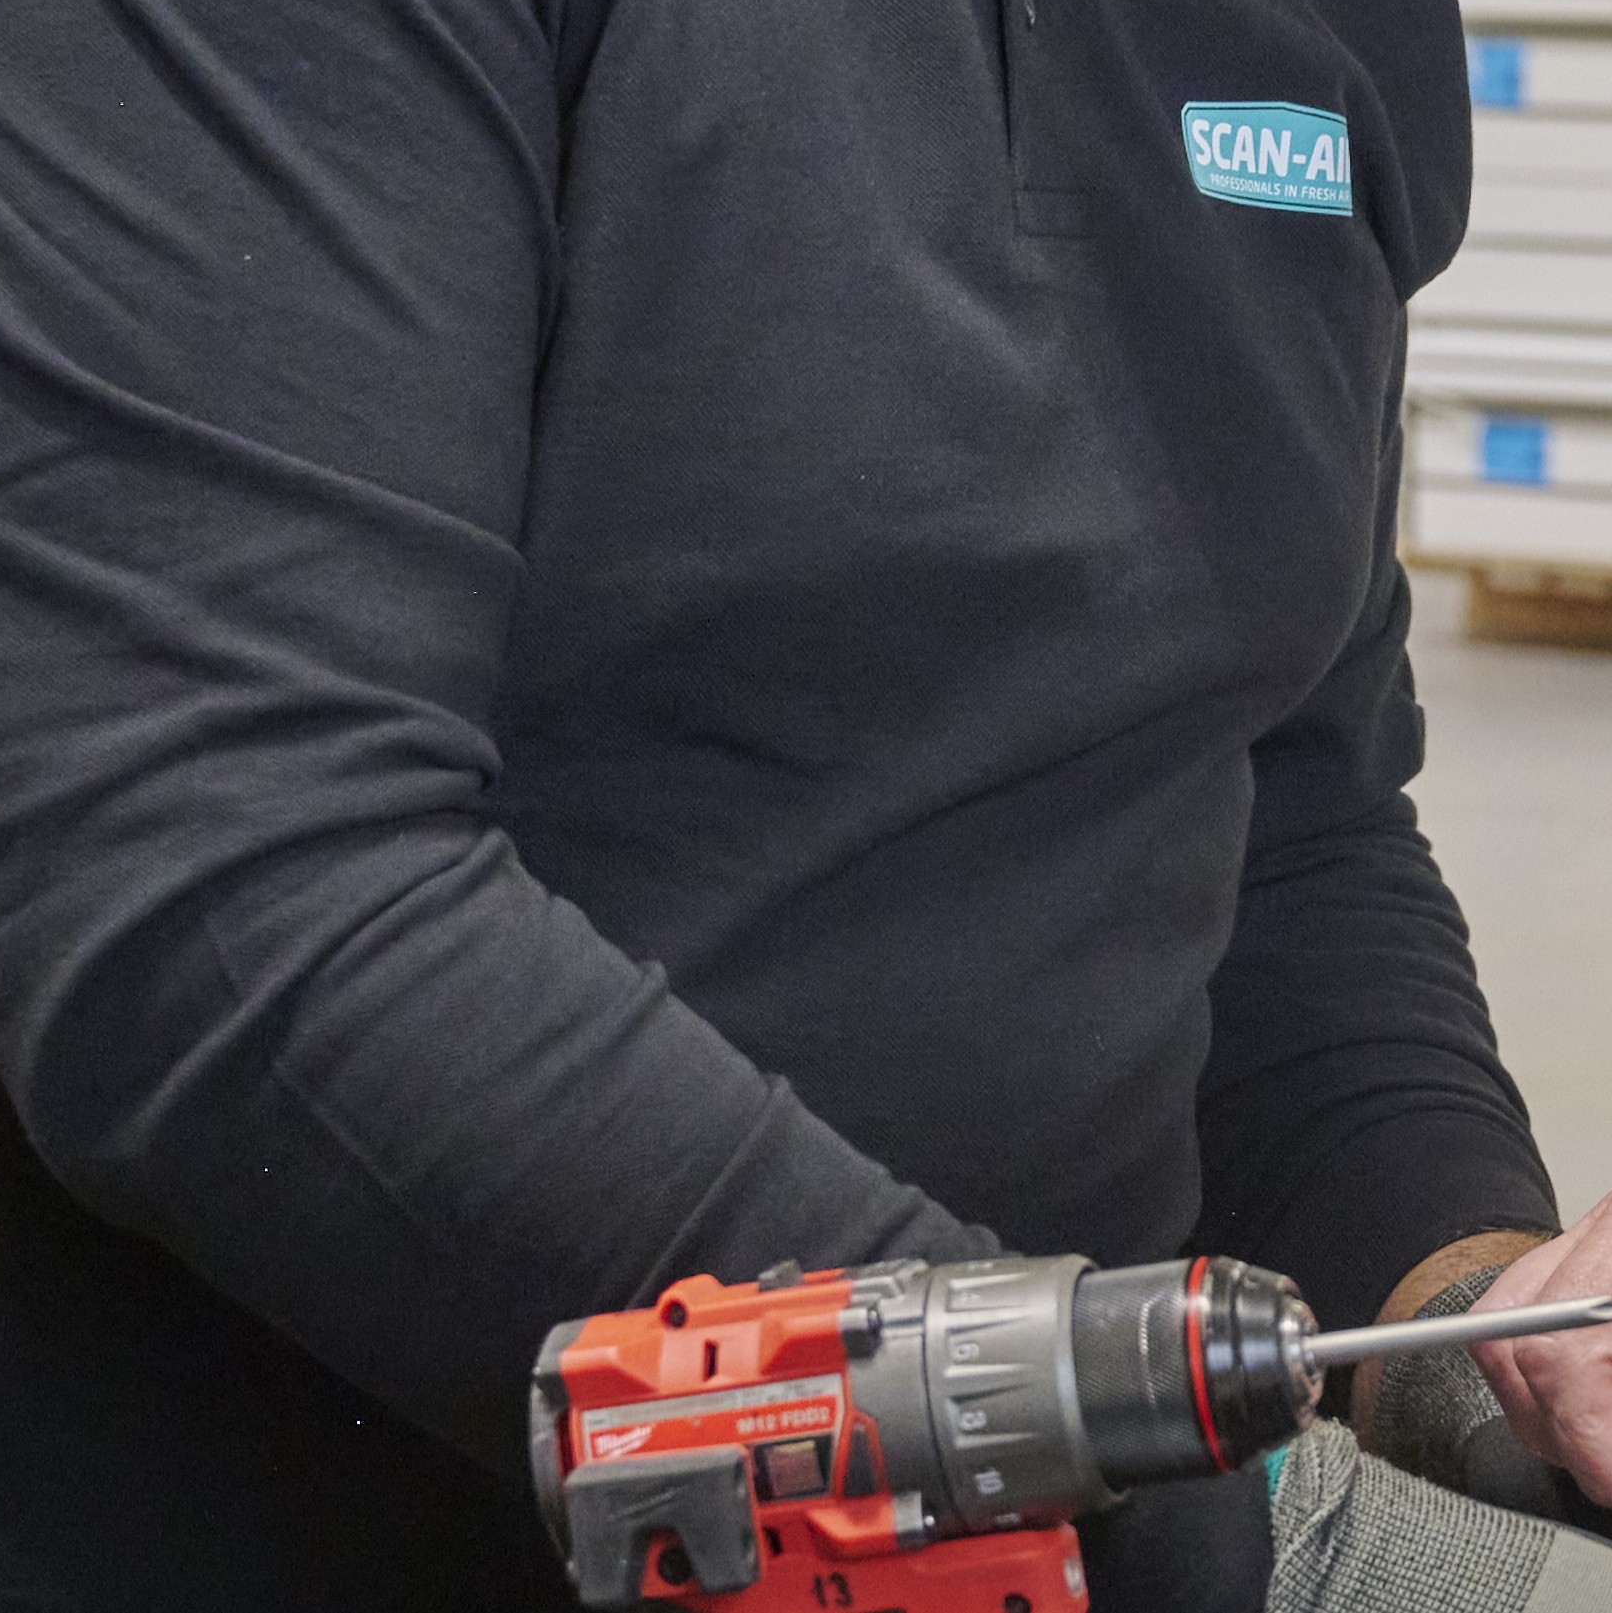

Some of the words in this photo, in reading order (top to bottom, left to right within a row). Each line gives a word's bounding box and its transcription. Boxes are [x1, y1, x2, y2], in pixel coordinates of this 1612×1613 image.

[1210, 173, 1280, 196] PROFESSIONALS
[1284, 184, 1297, 197] IN
[1301, 186, 1337, 201] FRESH
[812, 1572, 853, 1608] 13
